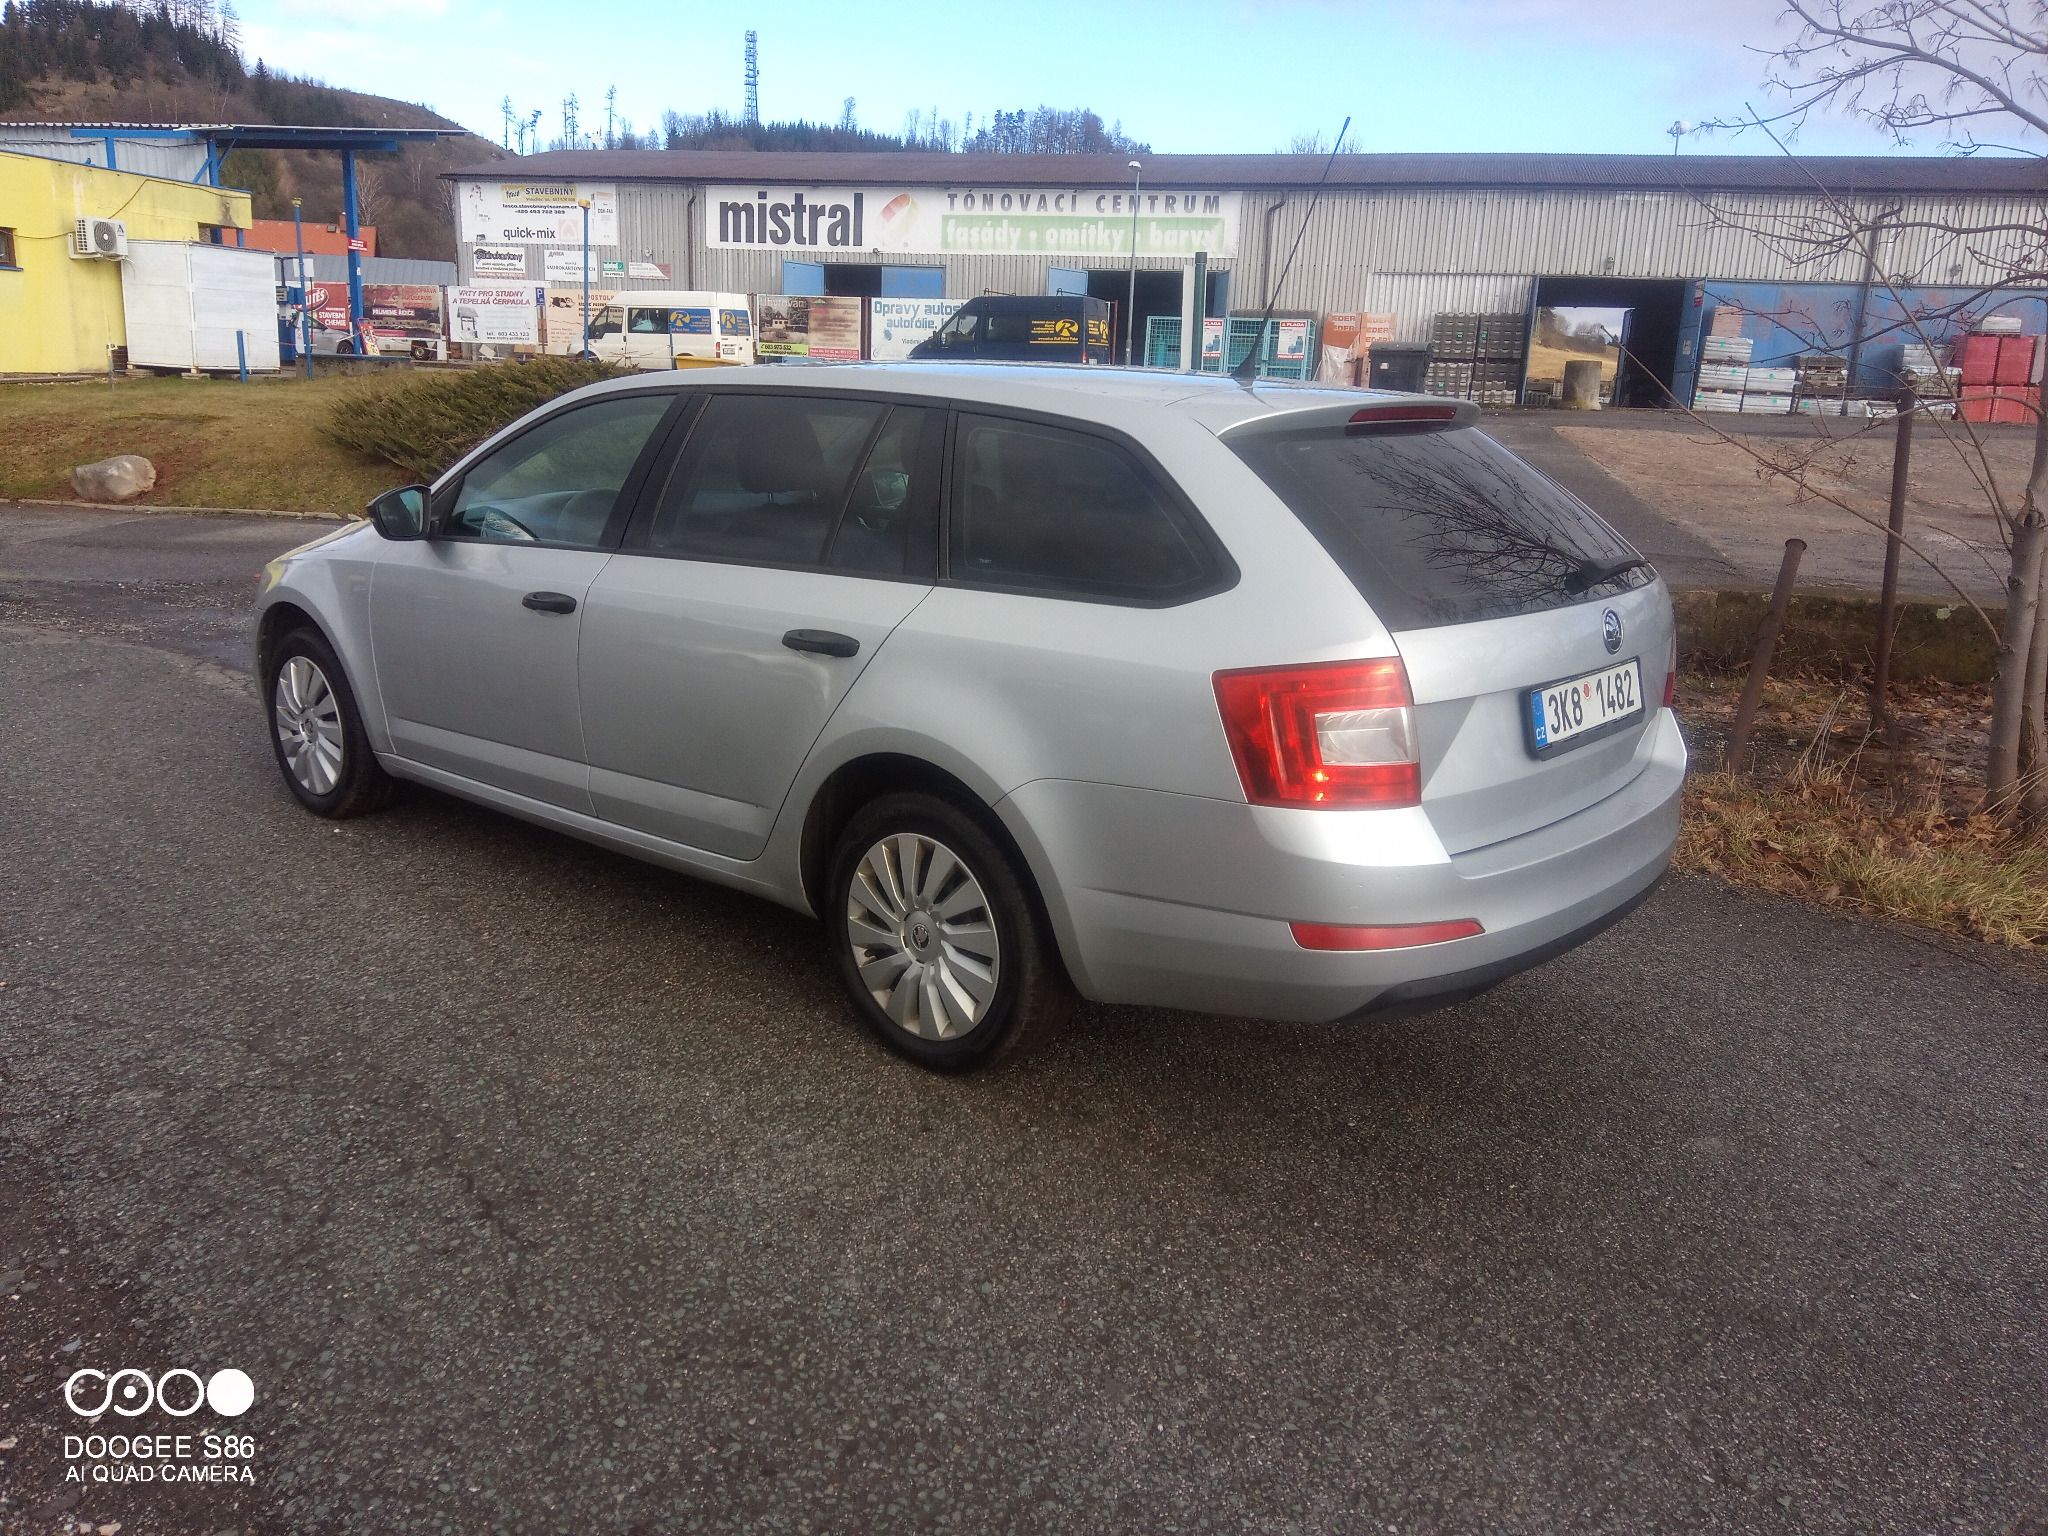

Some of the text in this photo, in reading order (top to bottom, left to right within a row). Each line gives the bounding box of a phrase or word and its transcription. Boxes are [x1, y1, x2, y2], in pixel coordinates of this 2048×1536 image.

[525, 187, 574, 196] STAVEBNINY
[947, 189, 1221, 214] TÓNOVACÍ CENTRUM
[719, 191, 863, 247] mistral
[503, 227, 557, 240] quick-mix
[946, 218, 1022, 250] fasády
[1045, 220, 1126, 252] omítky
[495, 290, 525, 298] STUDNY
[537, 289, 543, 298] P
[459, 297, 491, 305] TEPELNÁ
[492, 298, 531, 306] ČERPADLA
[319, 311, 346, 319] STAVEBNÍ
[874, 301, 920, 318] Opravy
[325, 319, 346, 327] CHEMIE
[886, 317, 937, 330] autofólie,
[1548, 669, 1635, 735] 3K8 1482
[1536, 726, 1546, 740] CZ
